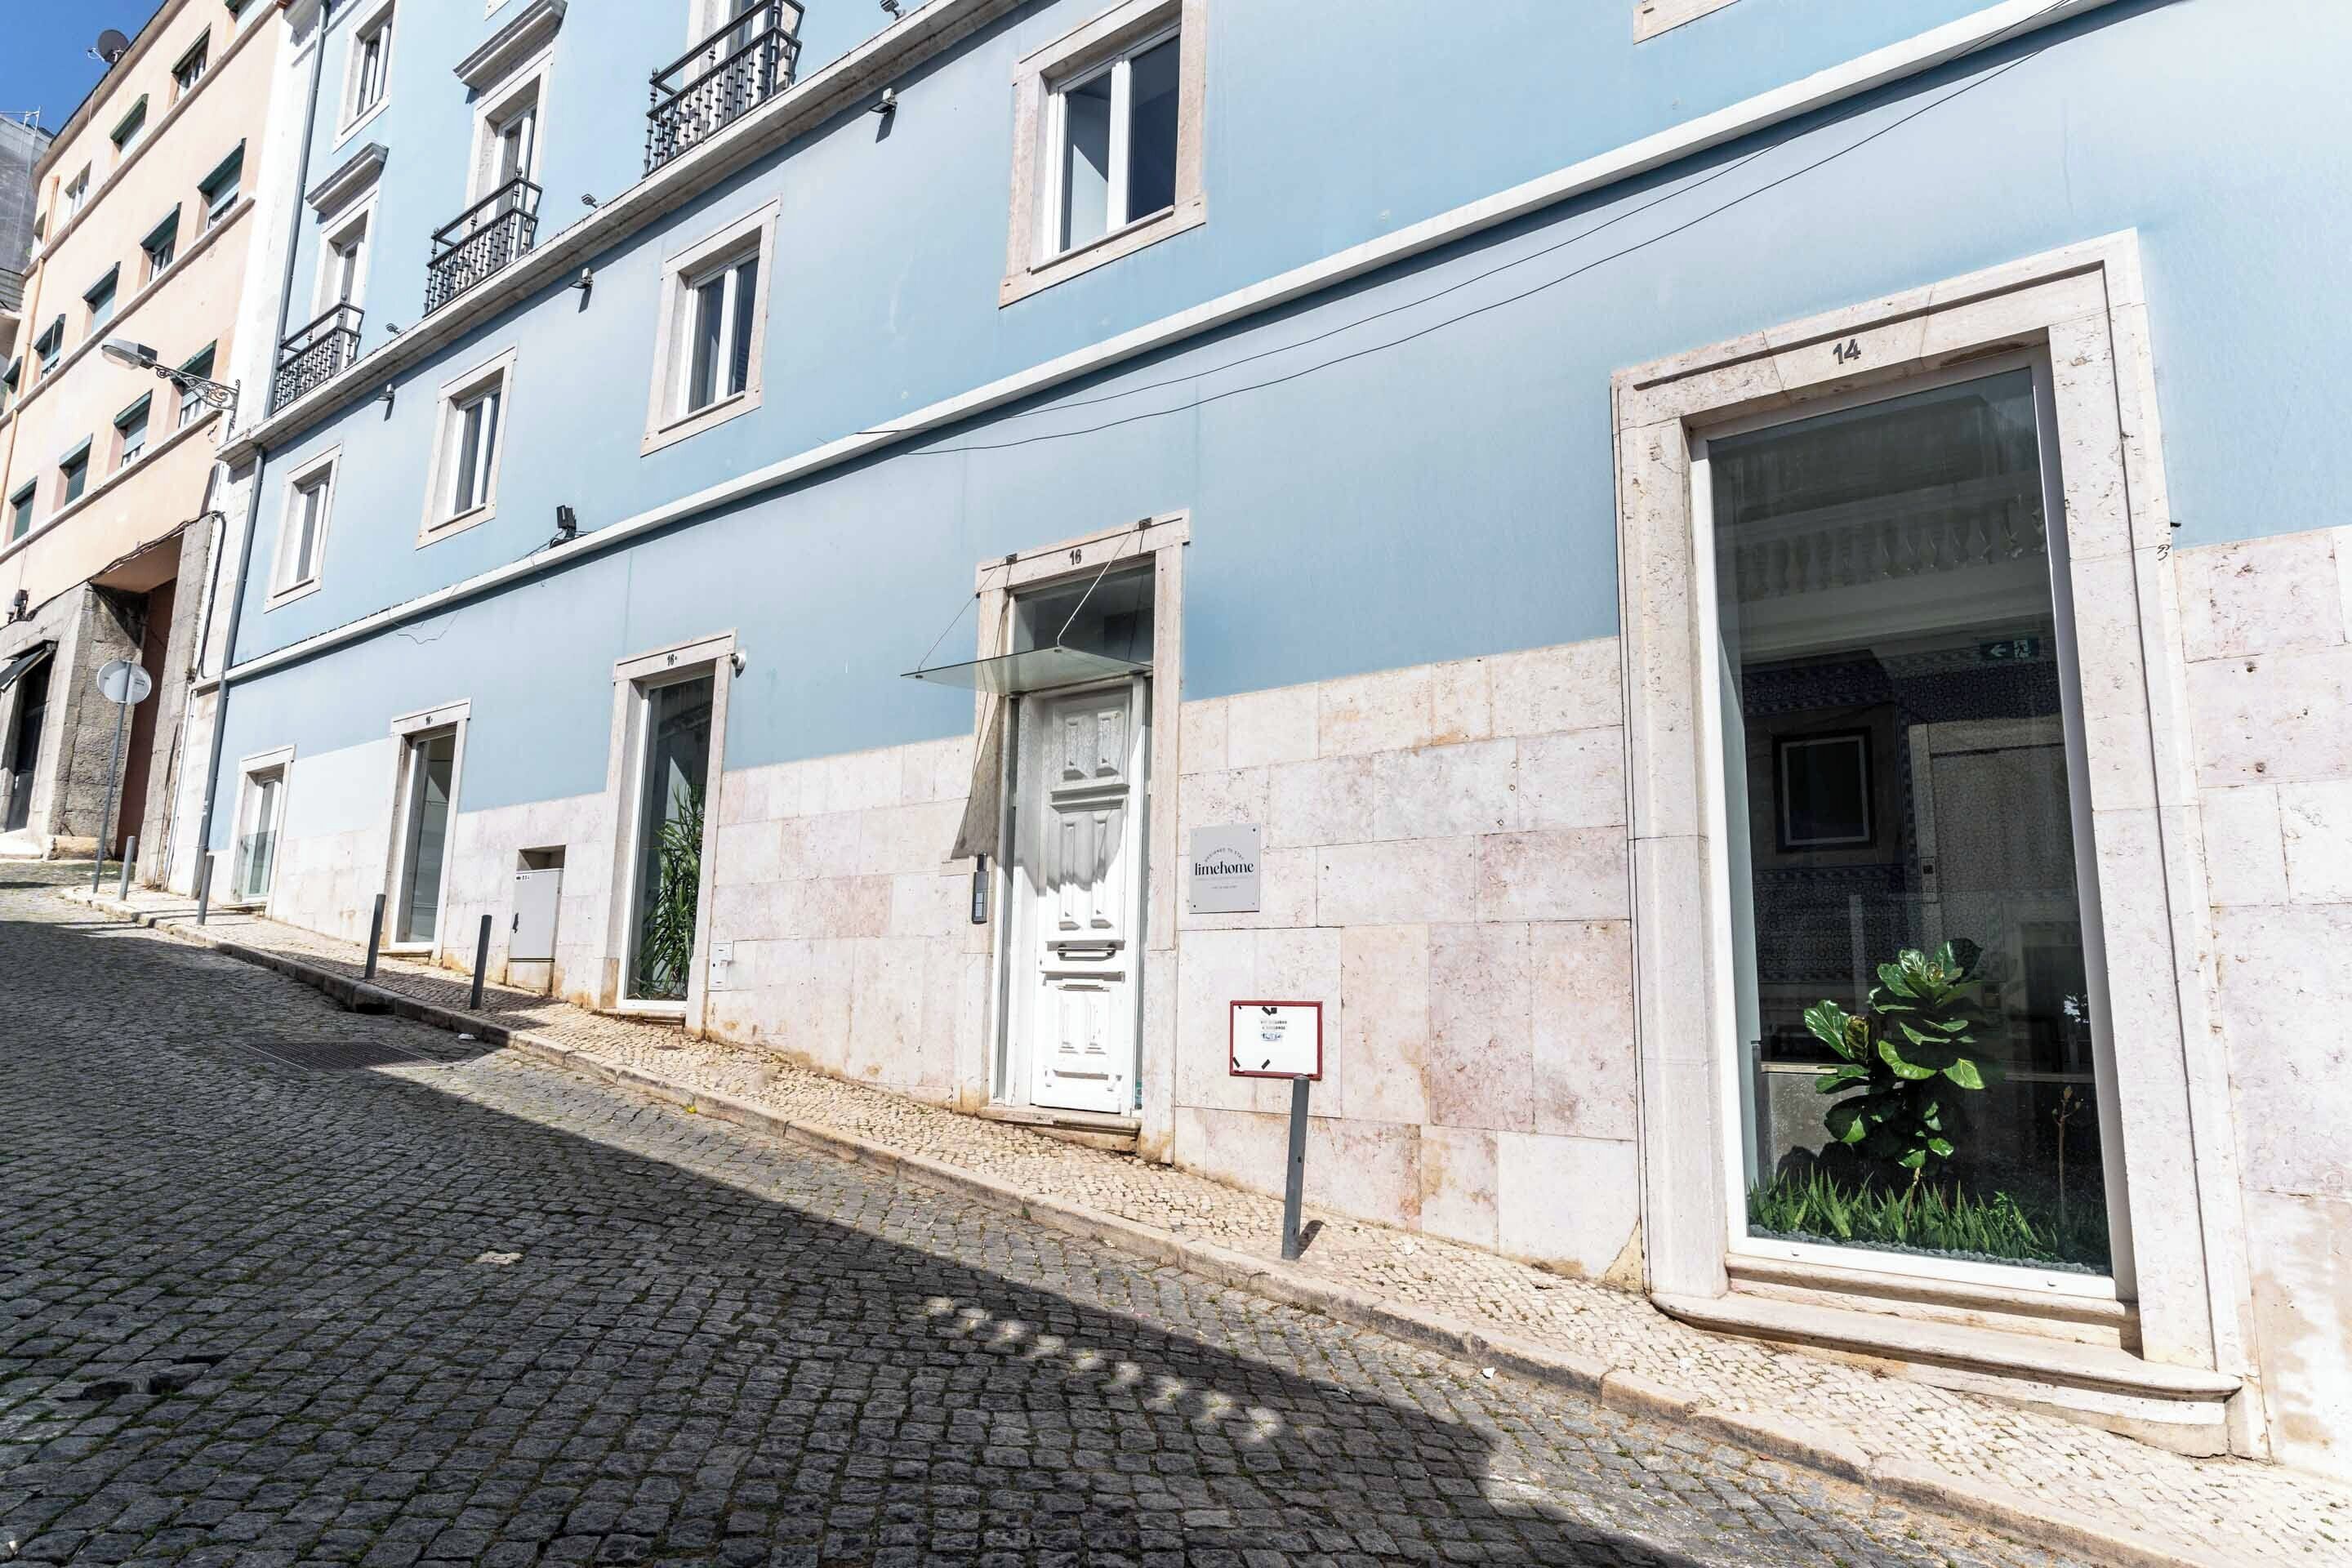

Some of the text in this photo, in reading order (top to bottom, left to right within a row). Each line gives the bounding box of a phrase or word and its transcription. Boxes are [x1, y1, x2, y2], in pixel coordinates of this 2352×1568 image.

[1833, 338, 1862, 365] 14
[1070, 548, 1082, 565] 16
[1195, 860, 1254, 876] limehome
